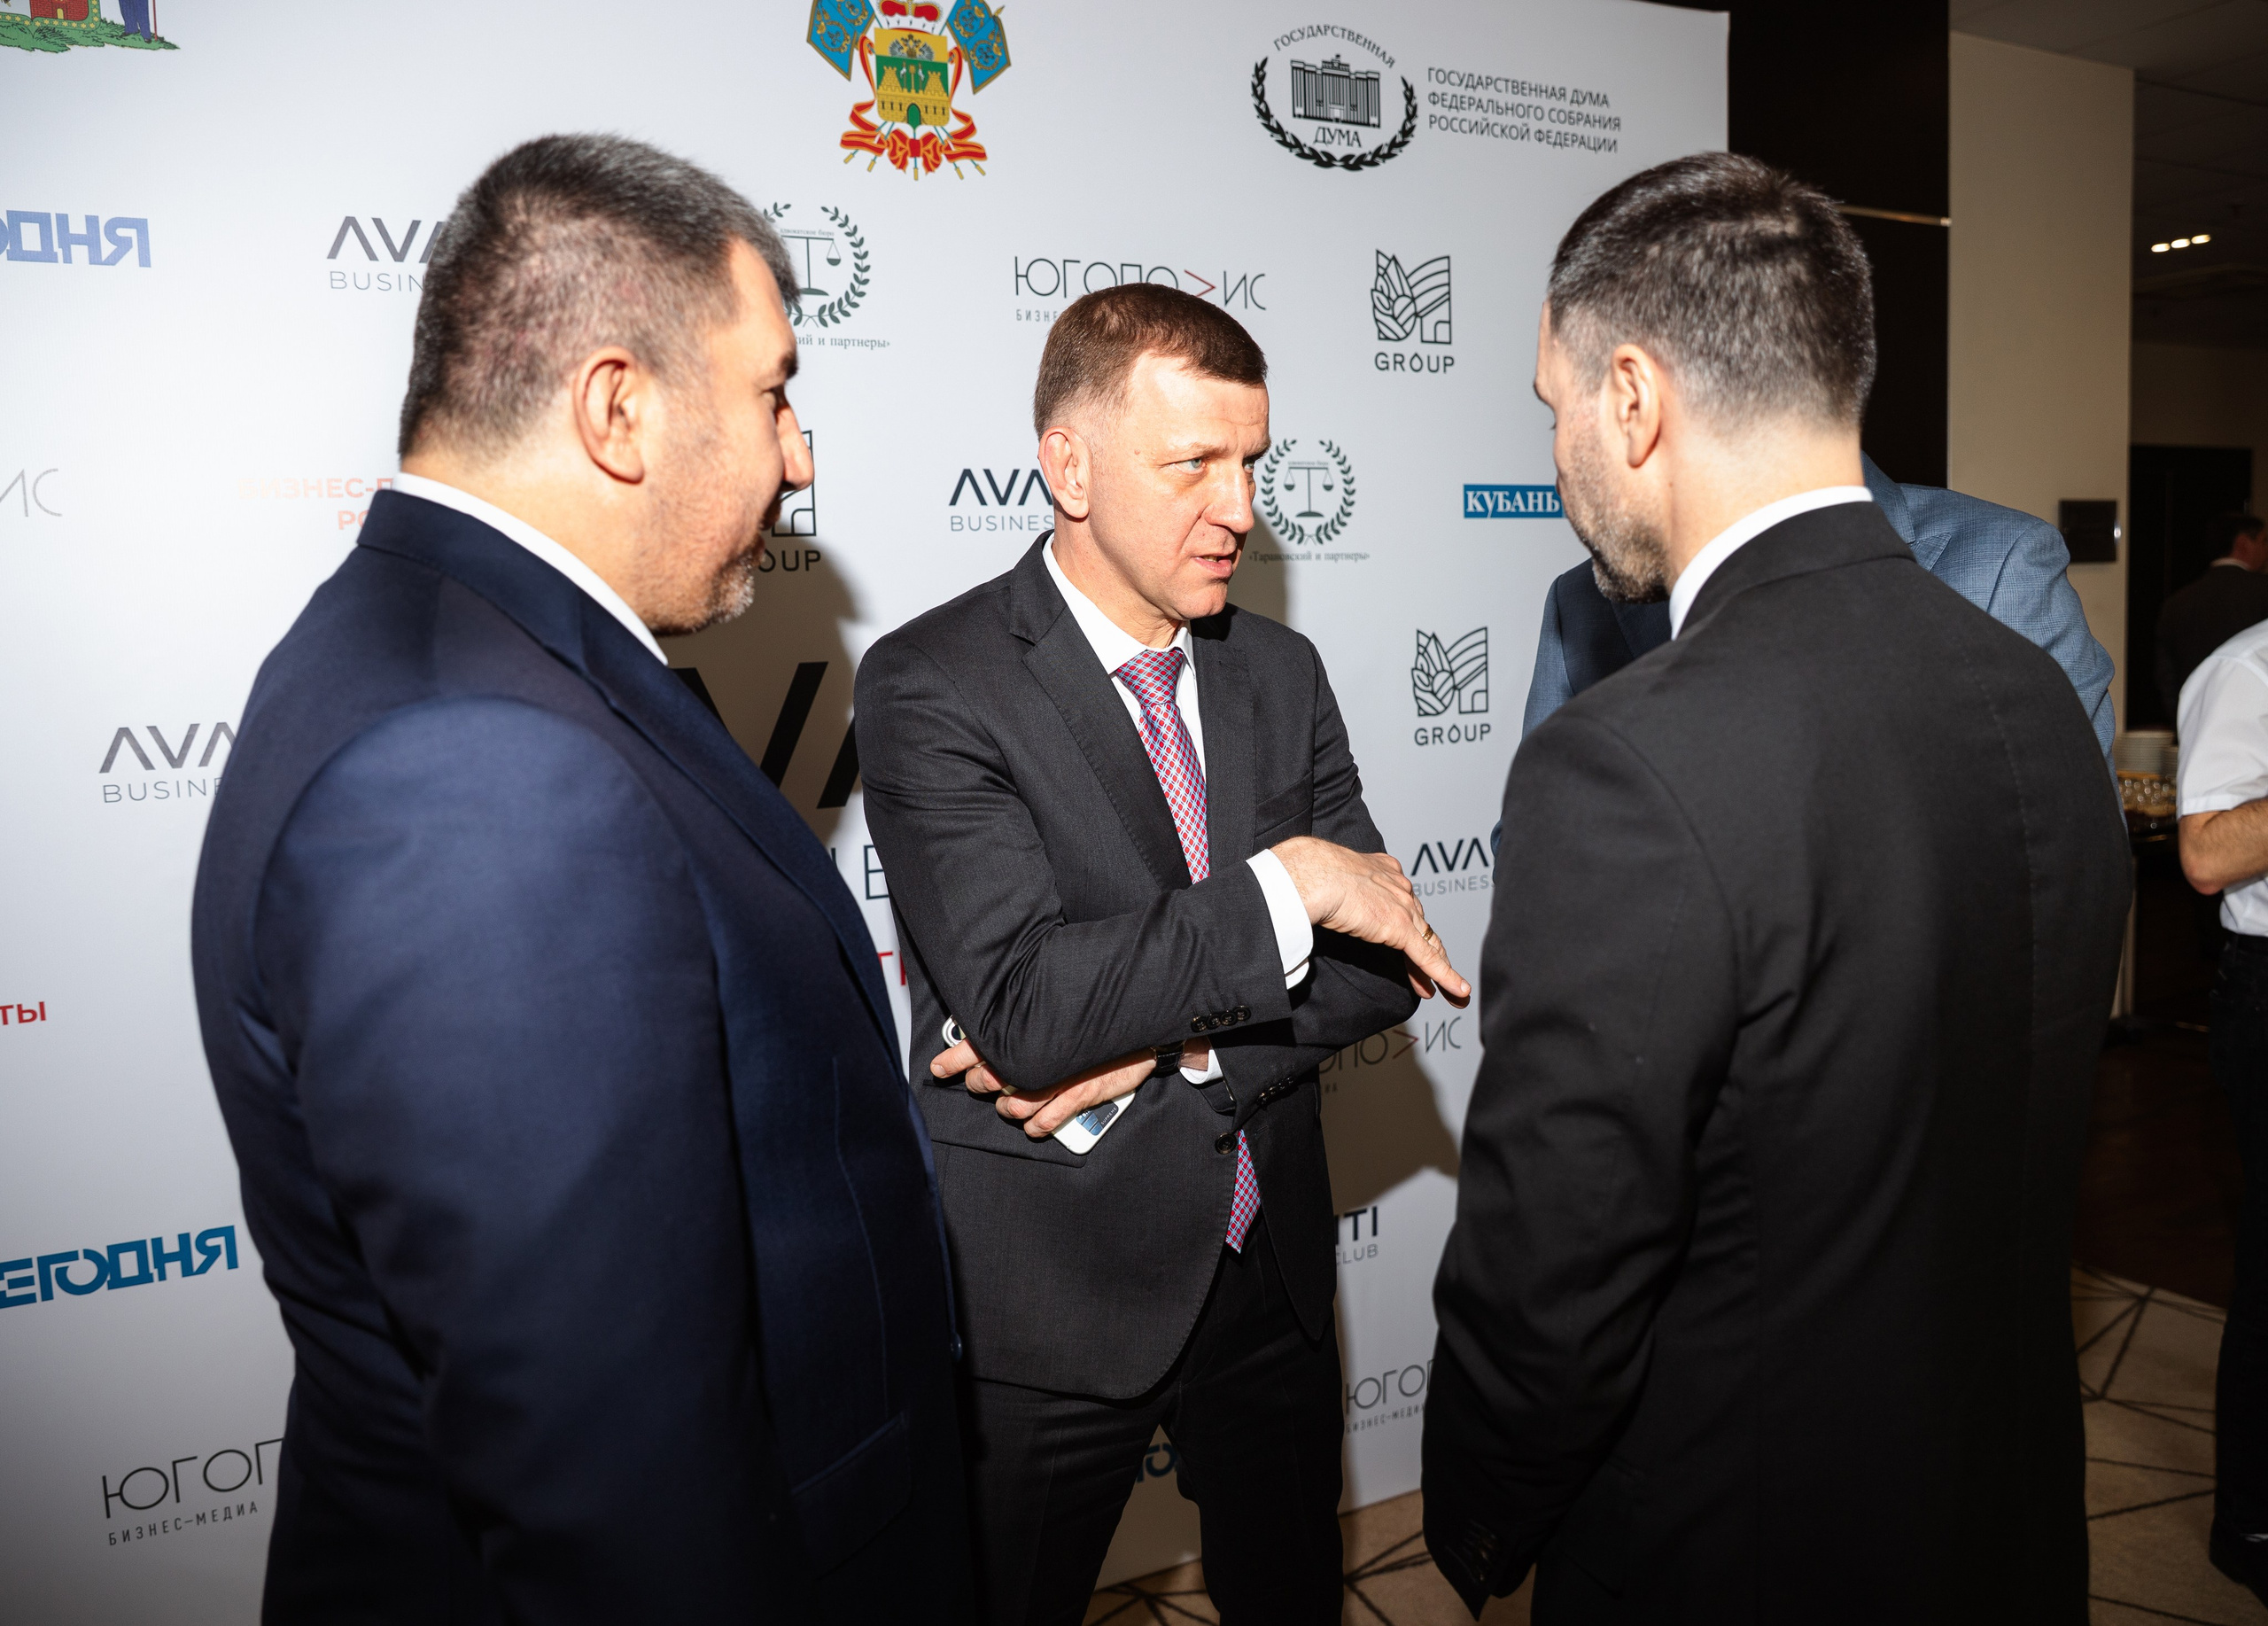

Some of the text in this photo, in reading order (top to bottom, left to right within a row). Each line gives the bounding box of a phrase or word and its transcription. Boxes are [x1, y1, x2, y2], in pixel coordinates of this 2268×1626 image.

[1273, 25, 1396, 69] ГОСУДАРСТВЕННАЯ
[1427, 67, 1611, 109] ГОСУДАРСТВЕННАЯ ДУМА
[1427, 91, 1622, 132] ФЕДЕРАЛЬНОГО СОБРАНИЯ
[1312, 126, 1363, 148] ДУМА
[1428, 113, 1619, 153] РОССИЙСКОЙ ФЕДЕРАЦИИ
[0, 209, 151, 268] ДНЯ
[1374, 352, 1455, 374] GROUP
[950, 515, 1054, 532] BUSINES
[1414, 723, 1491, 746] GROUP
[1410, 836, 1490, 877] AVA
[108, 1500, 259, 1546] БИЗНЕС-МЕДИА
